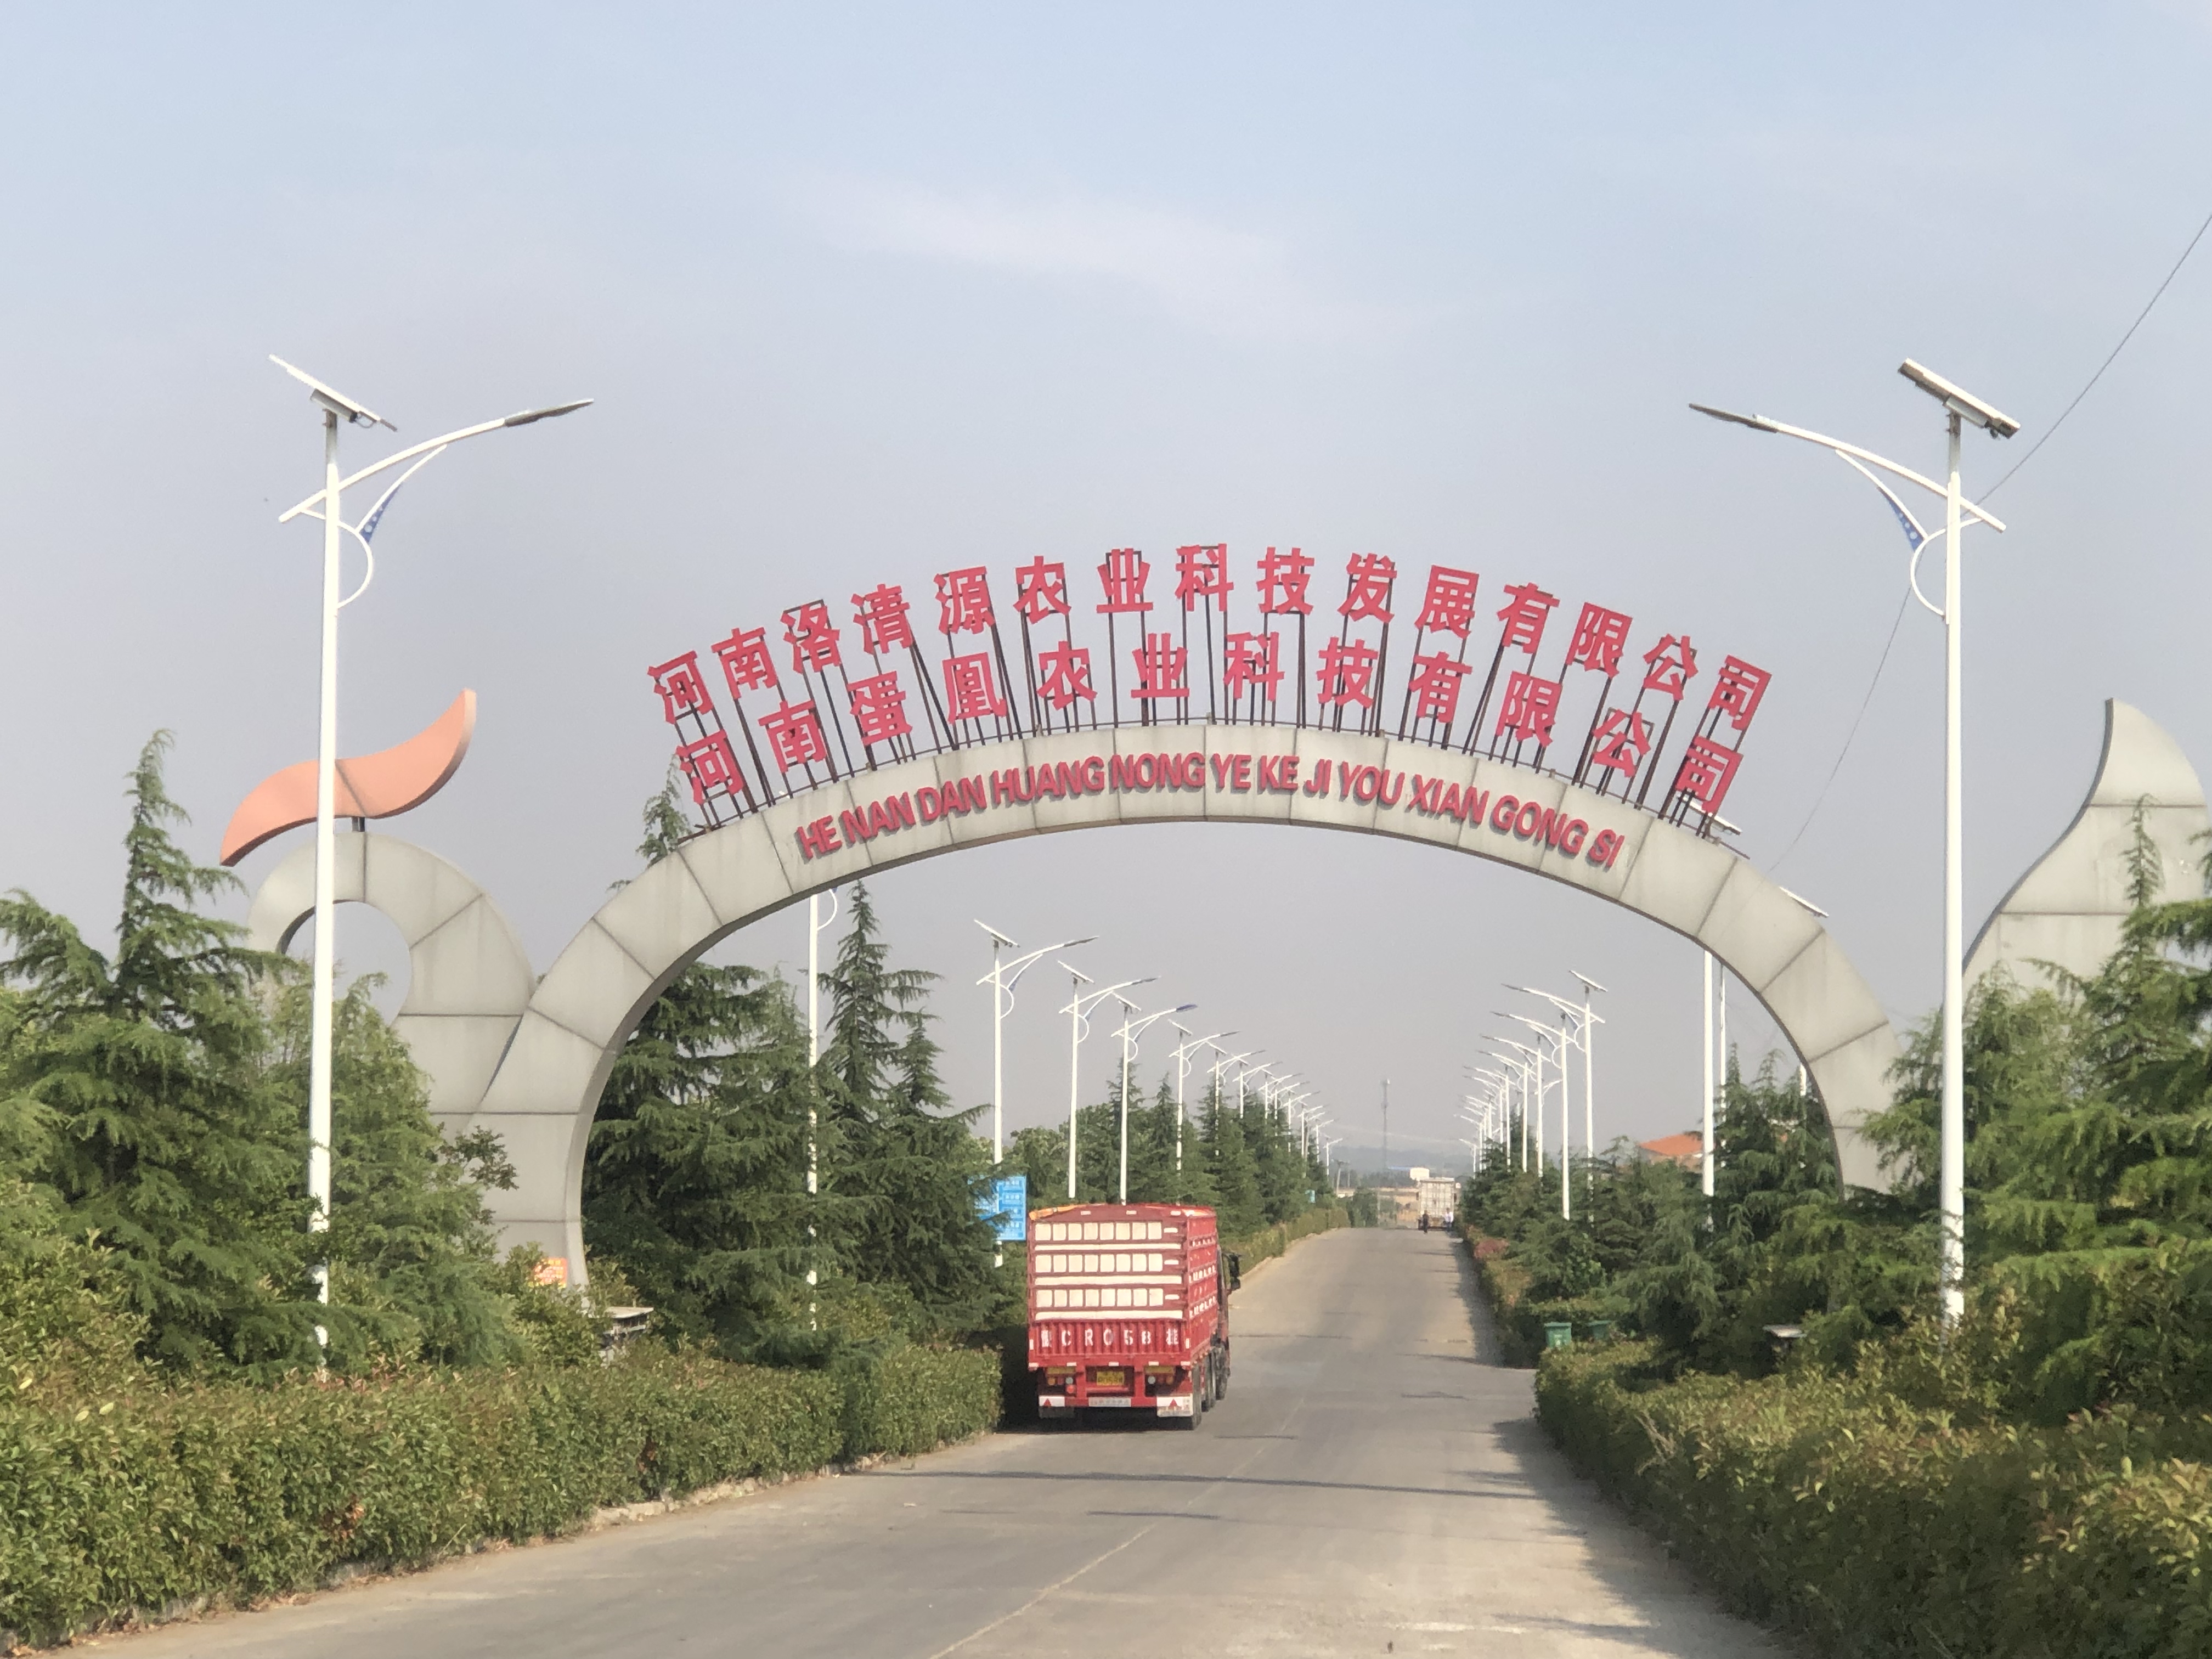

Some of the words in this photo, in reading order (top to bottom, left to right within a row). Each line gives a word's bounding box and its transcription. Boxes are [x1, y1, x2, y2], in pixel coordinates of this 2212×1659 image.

[647, 543, 1770, 724] 河南洛清源农业科技发展有限公司
[676, 631, 1741, 804] 河南蛋凰农业科技有限公司
[797, 815, 842, 859] HE
[840, 792, 916, 844] NAN
[917, 775, 987, 821] DAN
[992, 755, 1105, 804] HUANG
[1111, 752, 1205, 789] NONG
[1213, 753, 1251, 789] YE
[1260, 755, 1300, 789] KE
[1305, 759, 1332, 794] JI
[1341, 761, 1406, 805] YOU
[1408, 774, 1490, 825] XIAN
[1492, 795, 1589, 855] GONG
[1588, 829, 1625, 868] SI
